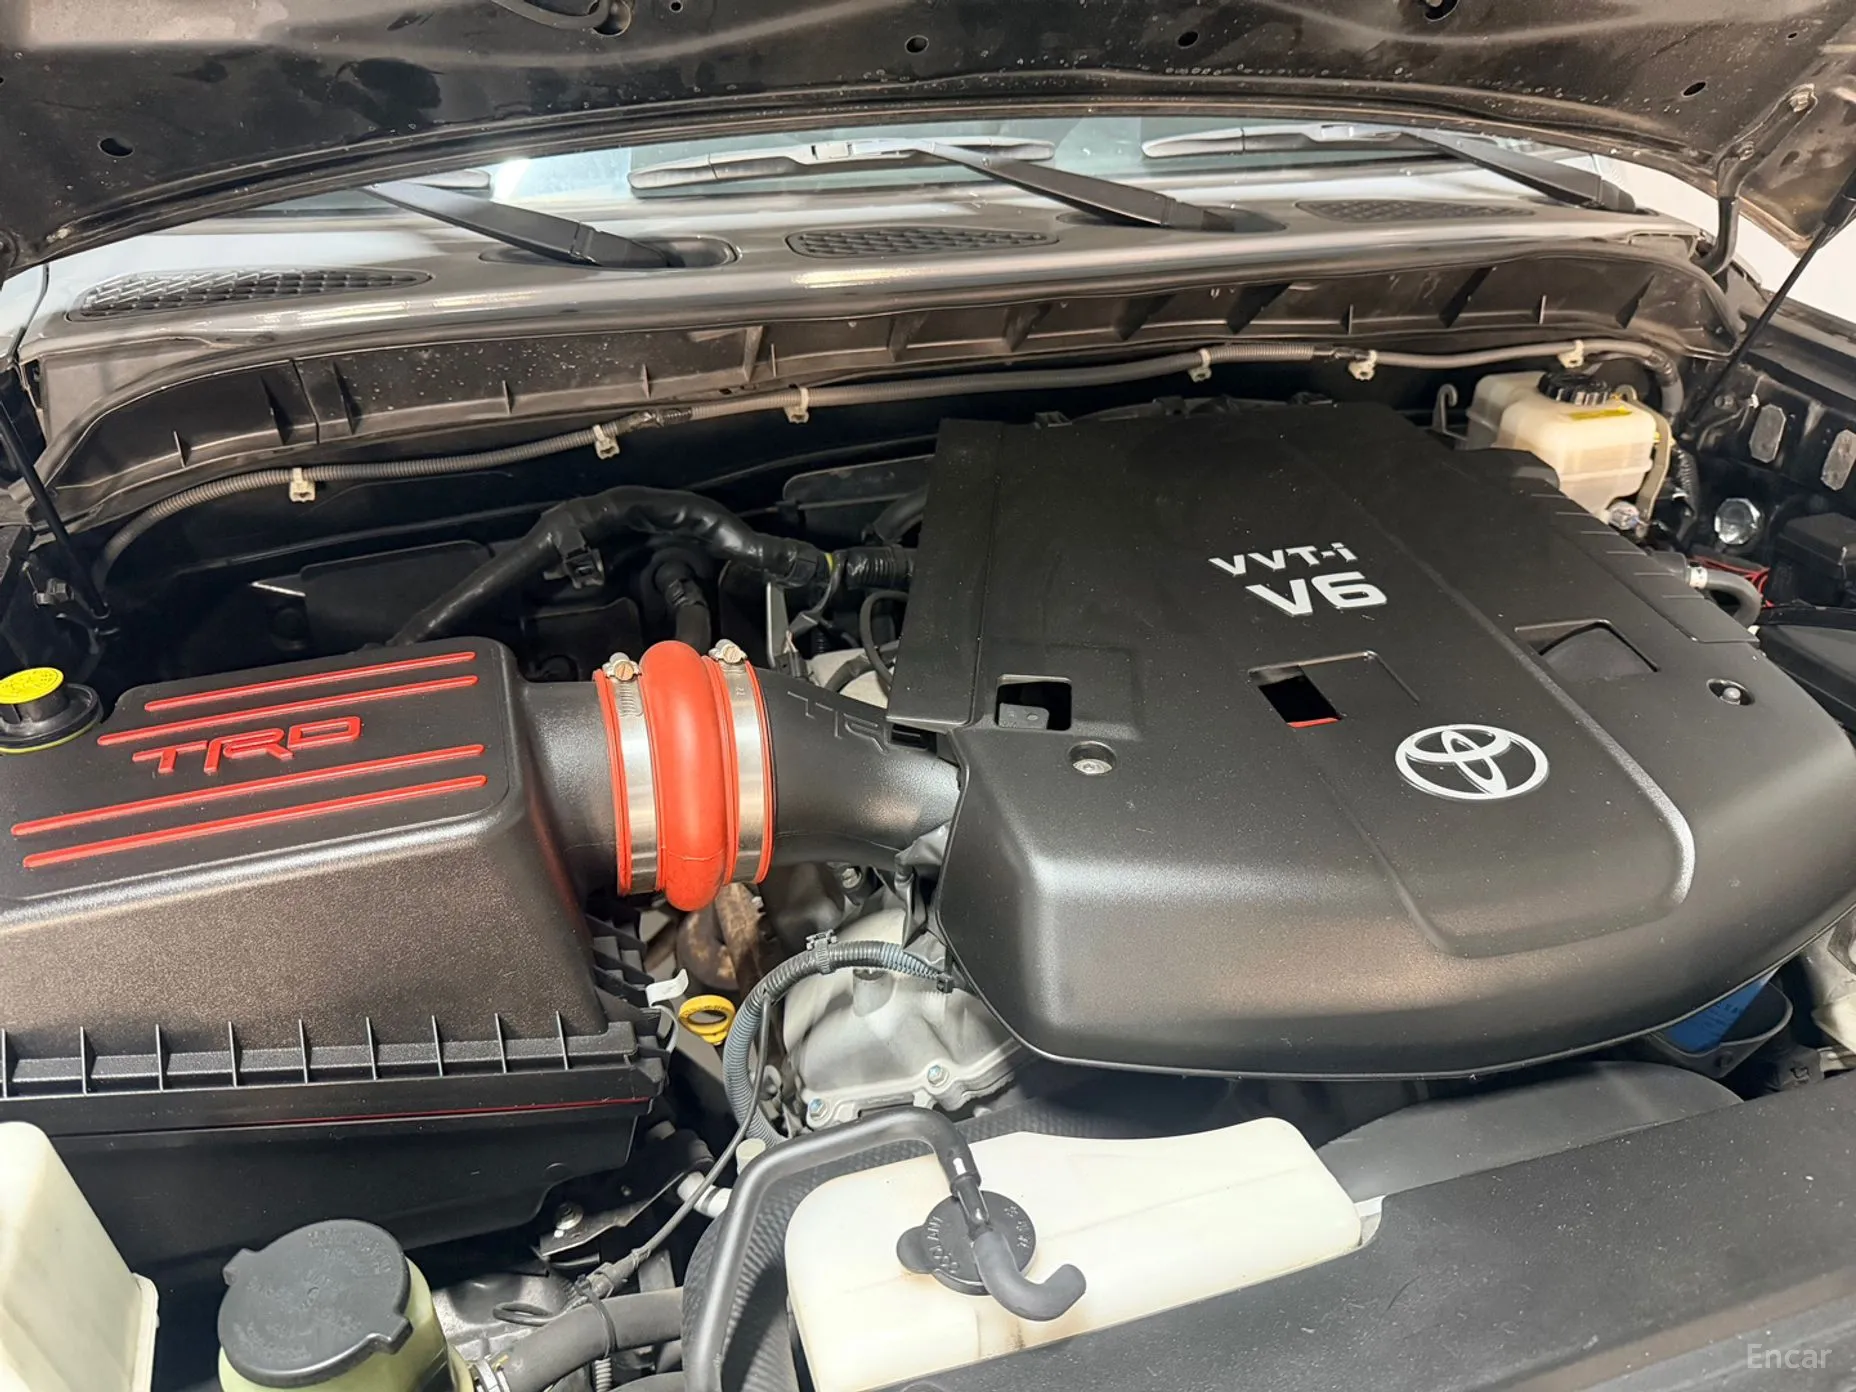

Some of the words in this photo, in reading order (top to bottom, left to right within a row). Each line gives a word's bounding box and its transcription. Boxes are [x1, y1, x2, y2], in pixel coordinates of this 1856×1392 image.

[1208, 542, 1358, 577] VVT-i
[1245, 571, 1388, 617] V6
[132, 716, 361, 775] TRD
